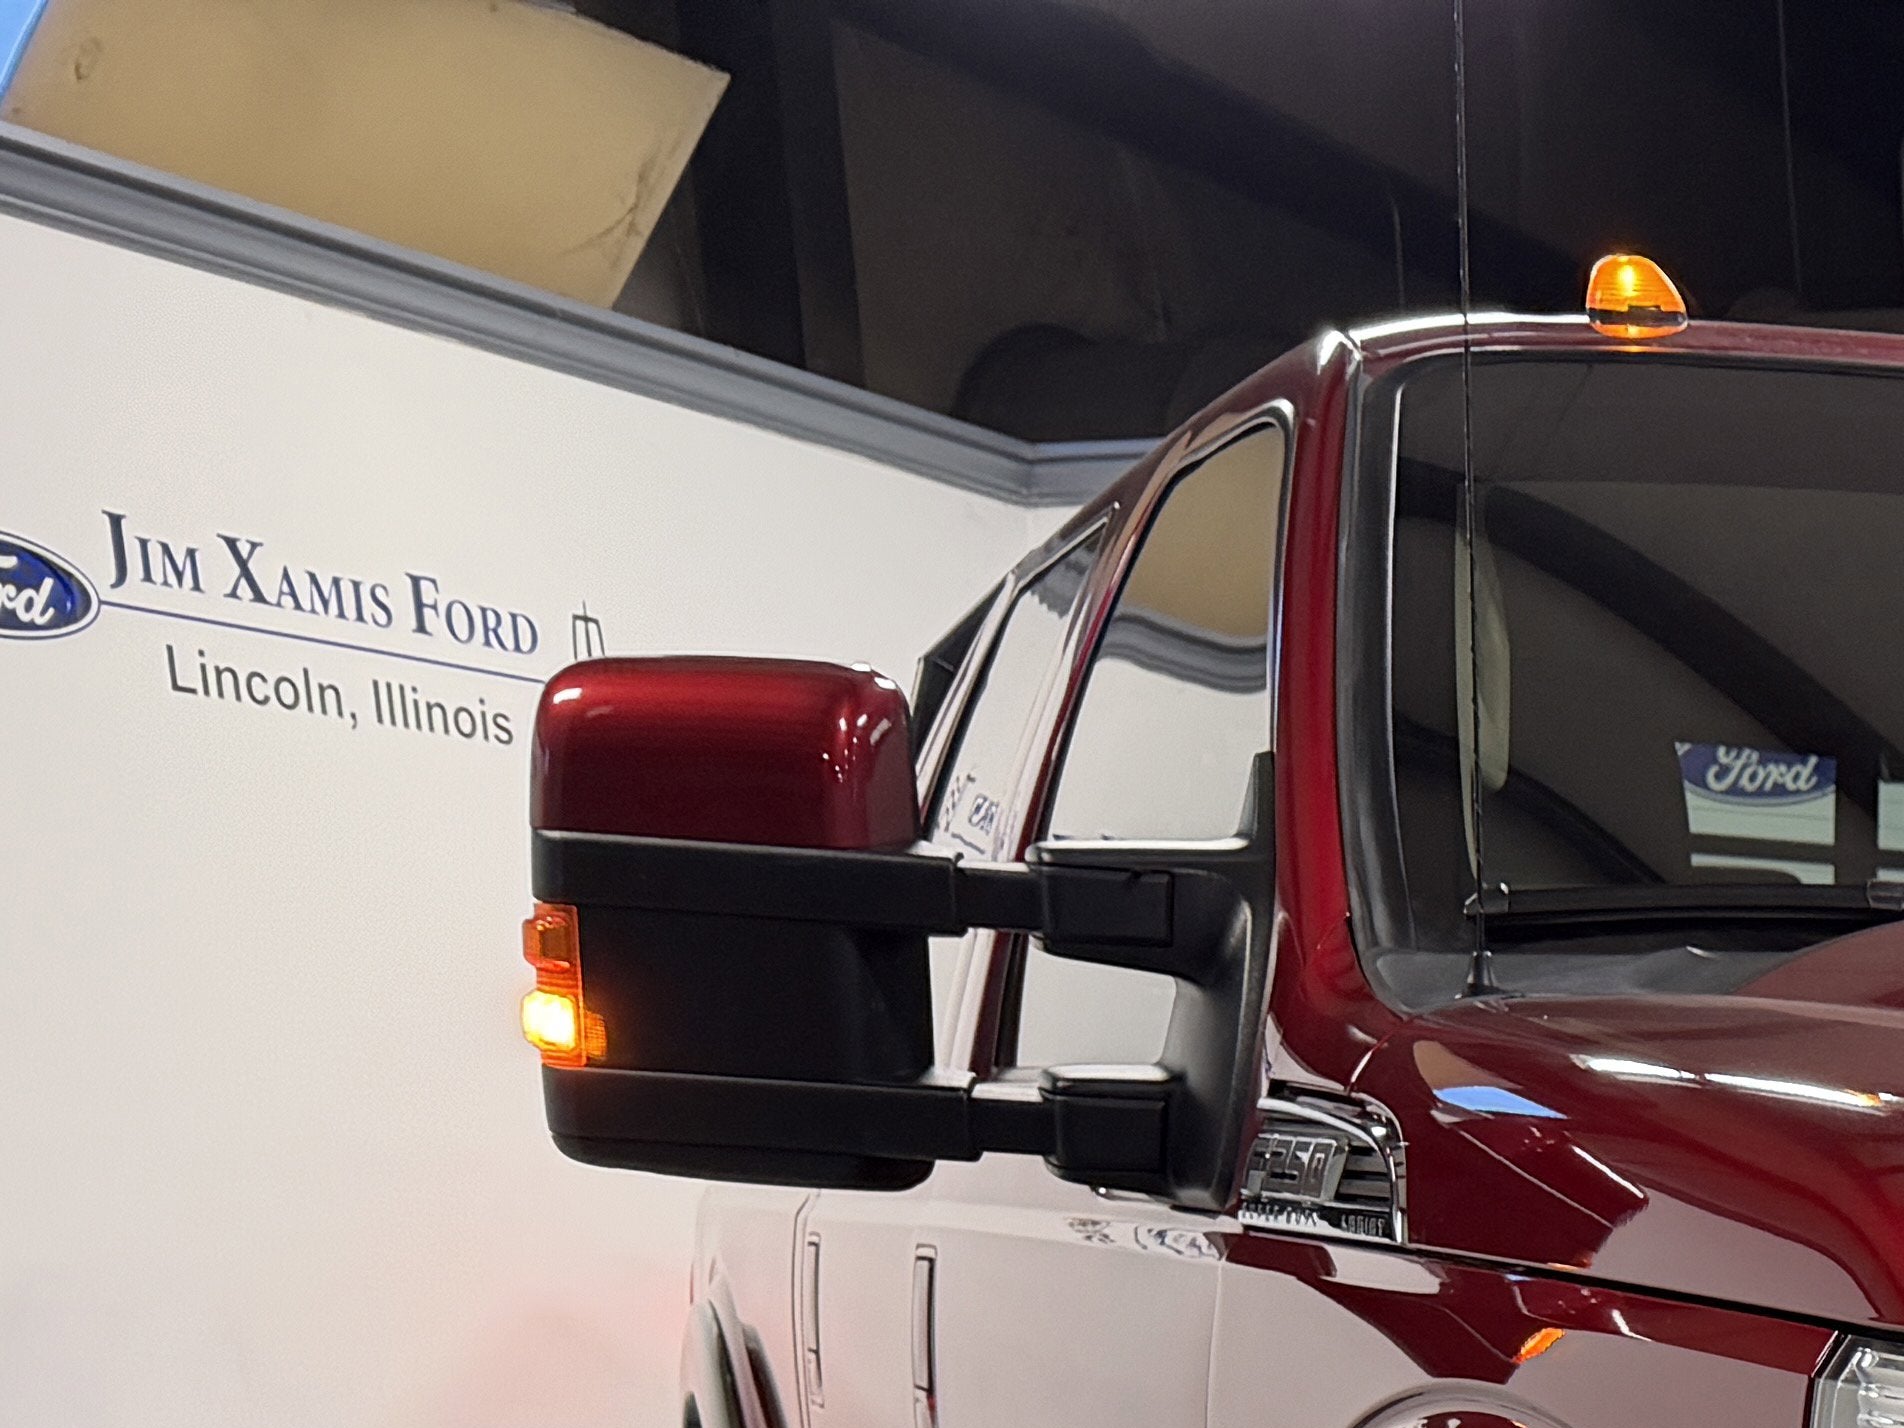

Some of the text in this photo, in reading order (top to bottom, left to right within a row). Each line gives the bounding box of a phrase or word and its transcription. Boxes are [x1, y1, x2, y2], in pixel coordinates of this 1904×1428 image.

[0, 555, 55, 625] rd
[101, 509, 539, 655] JIM XAMIS FORD
[166, 643, 514, 745] Lincoln, Illinois
